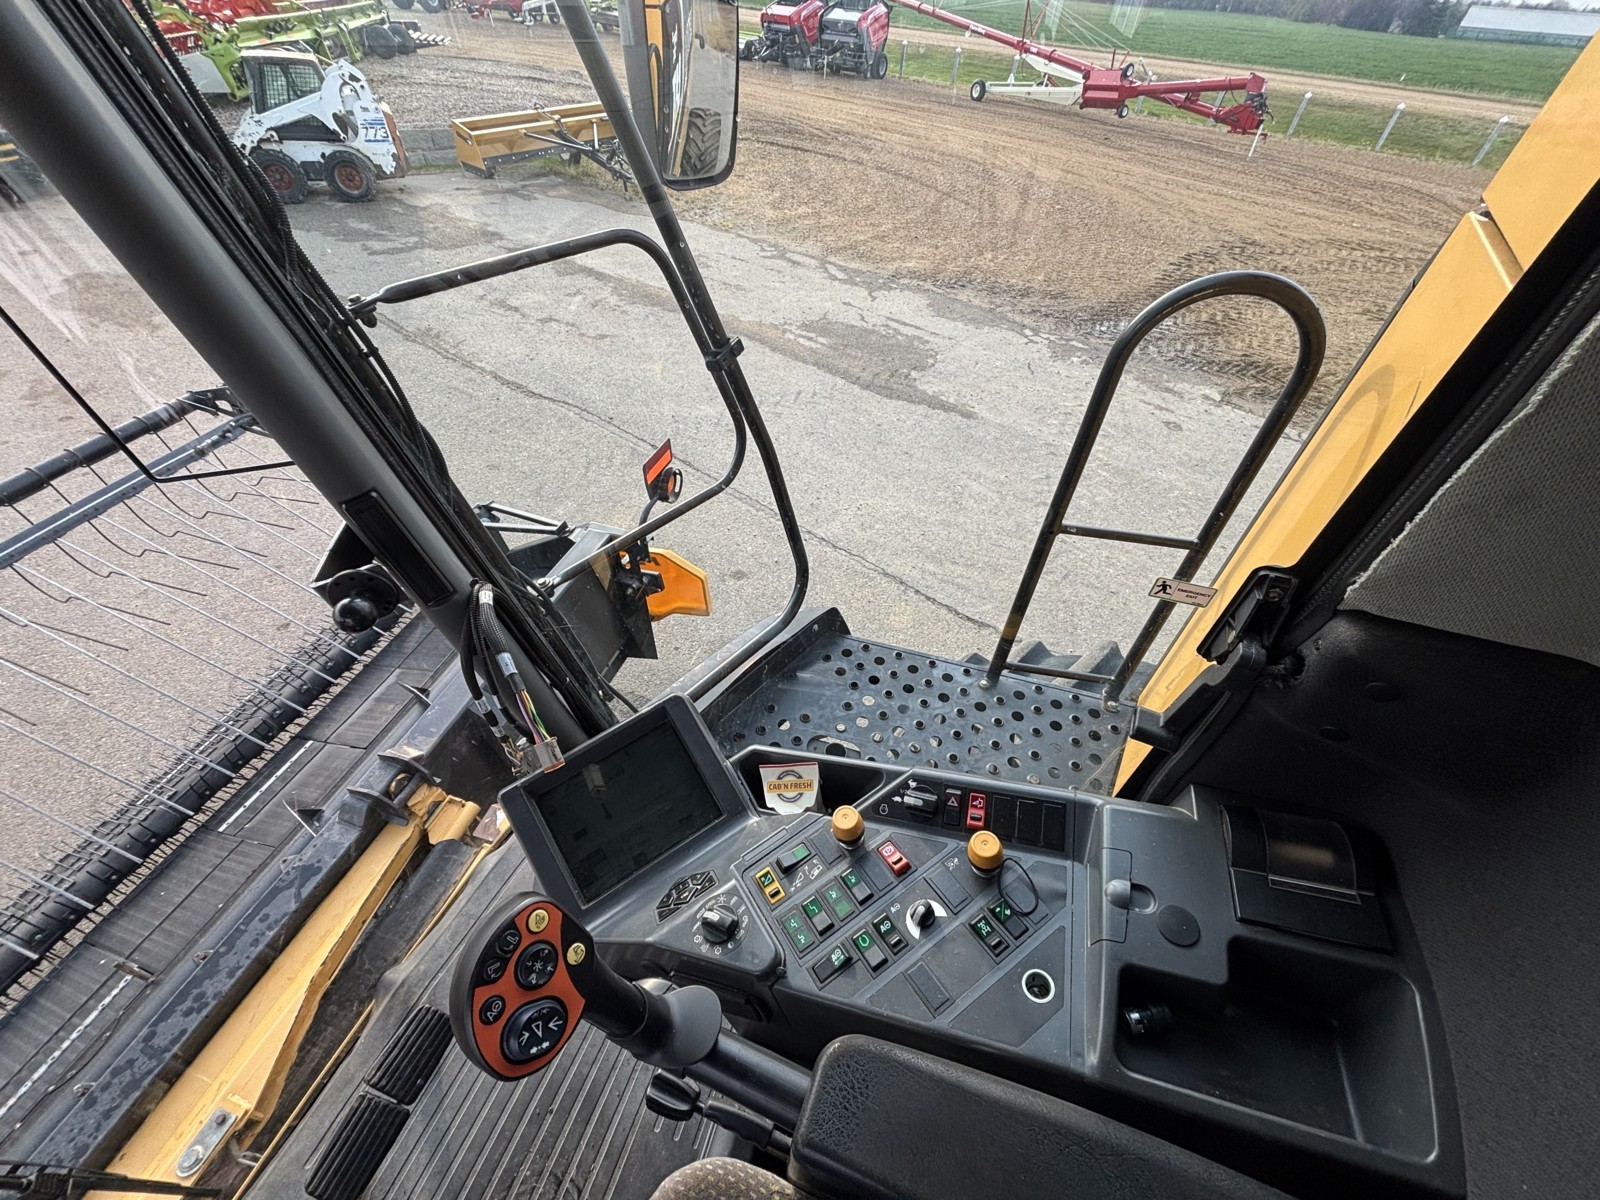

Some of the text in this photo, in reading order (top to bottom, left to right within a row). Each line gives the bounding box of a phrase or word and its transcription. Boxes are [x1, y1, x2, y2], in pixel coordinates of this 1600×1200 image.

[361, 126, 389, 139] 773
[1177, 588, 1211, 598] EMERGENCY
[768, 782, 812, 791] CAB'N FRESH
[536, 912, 546, 930] STOP
